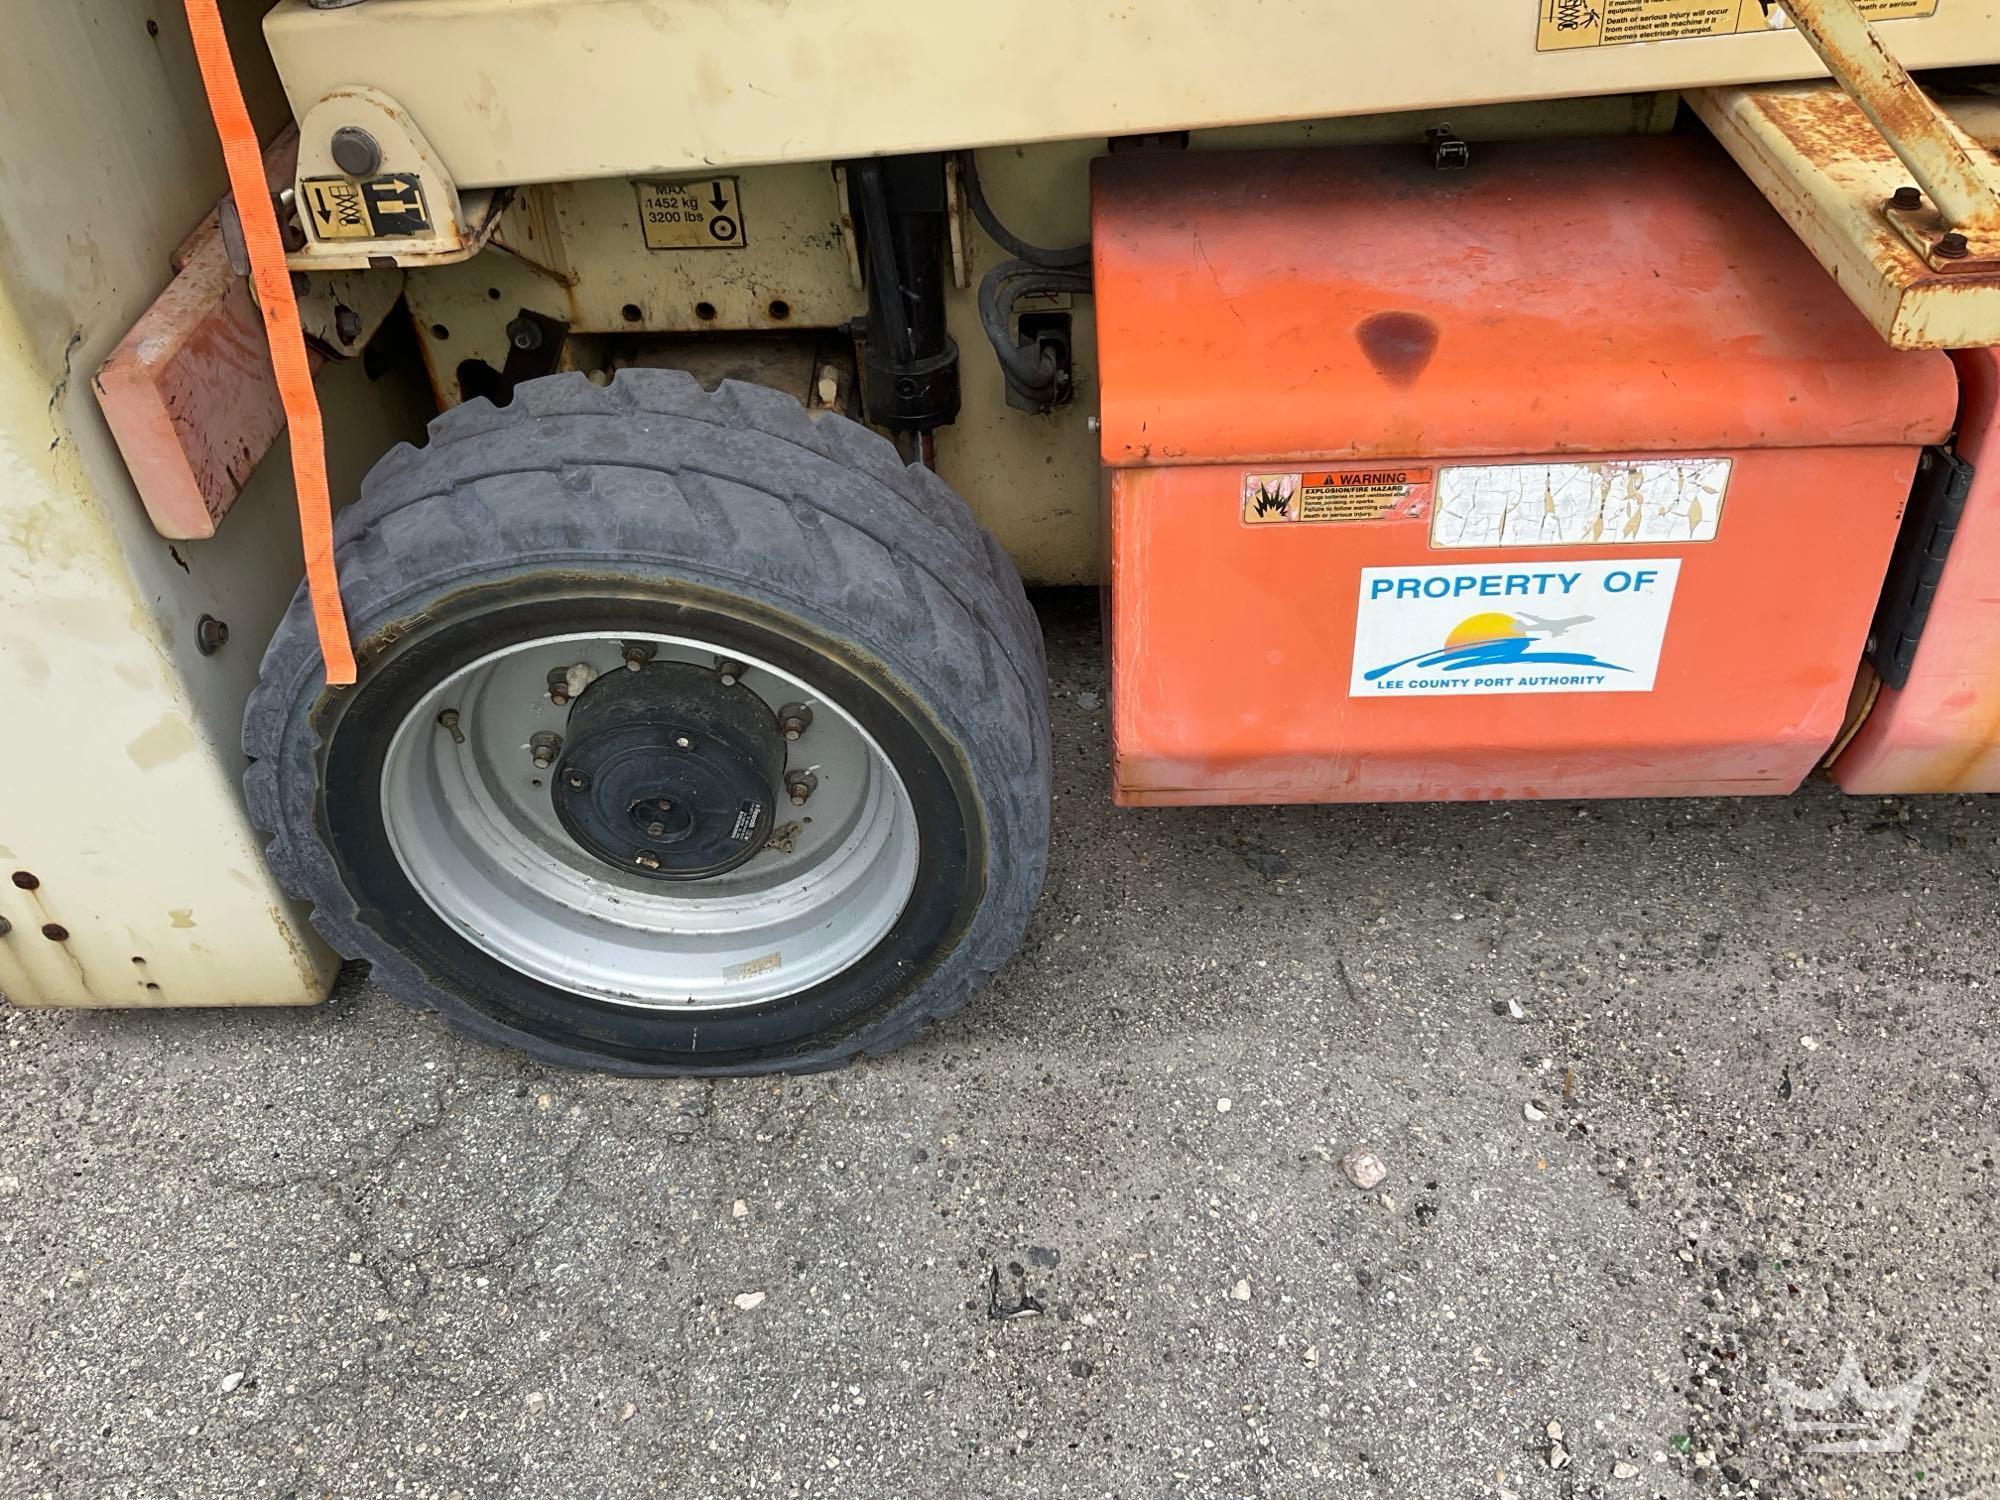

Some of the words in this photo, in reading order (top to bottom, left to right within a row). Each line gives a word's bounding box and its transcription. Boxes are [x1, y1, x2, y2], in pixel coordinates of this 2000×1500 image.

[1607, 6, 1643, 15] equipment.
[1889, 1, 1917, 9] serious
[1606, 17, 1628, 25] Death
[1640, 14, 1668, 22] serious
[1669, 11, 1690, 20] injury
[1624, 23, 1652, 31] contact
[1654, 21, 1670, 29] with
[1671, 19, 1702, 27] machine
[1604, 34, 1638, 42] becomes
[1639, 29, 1680, 39] electrically
[1680, 26, 1712, 35] charged.
[655, 184, 687, 195] MAX
[647, 197, 678, 209] 1452
[682, 197, 698, 210] kg
[649, 211, 681, 223] 3200
[684, 211, 704, 222] lbs
[1340, 472, 1407, 485] WARNING
[1305, 486, 1369, 495] EXPLOSION/FIRE
[1370, 485, 1403, 493] HAZARD
[1371, 572, 1581, 600] PROPERTY
[1603, 570, 1658, 593] OF
[1377, 680, 1404, 690] LEE
[1408, 678, 1470, 689] COUNTY
[1474, 677, 1514, 688] PORT
[1518, 675, 1606, 687] AUTHORITY
